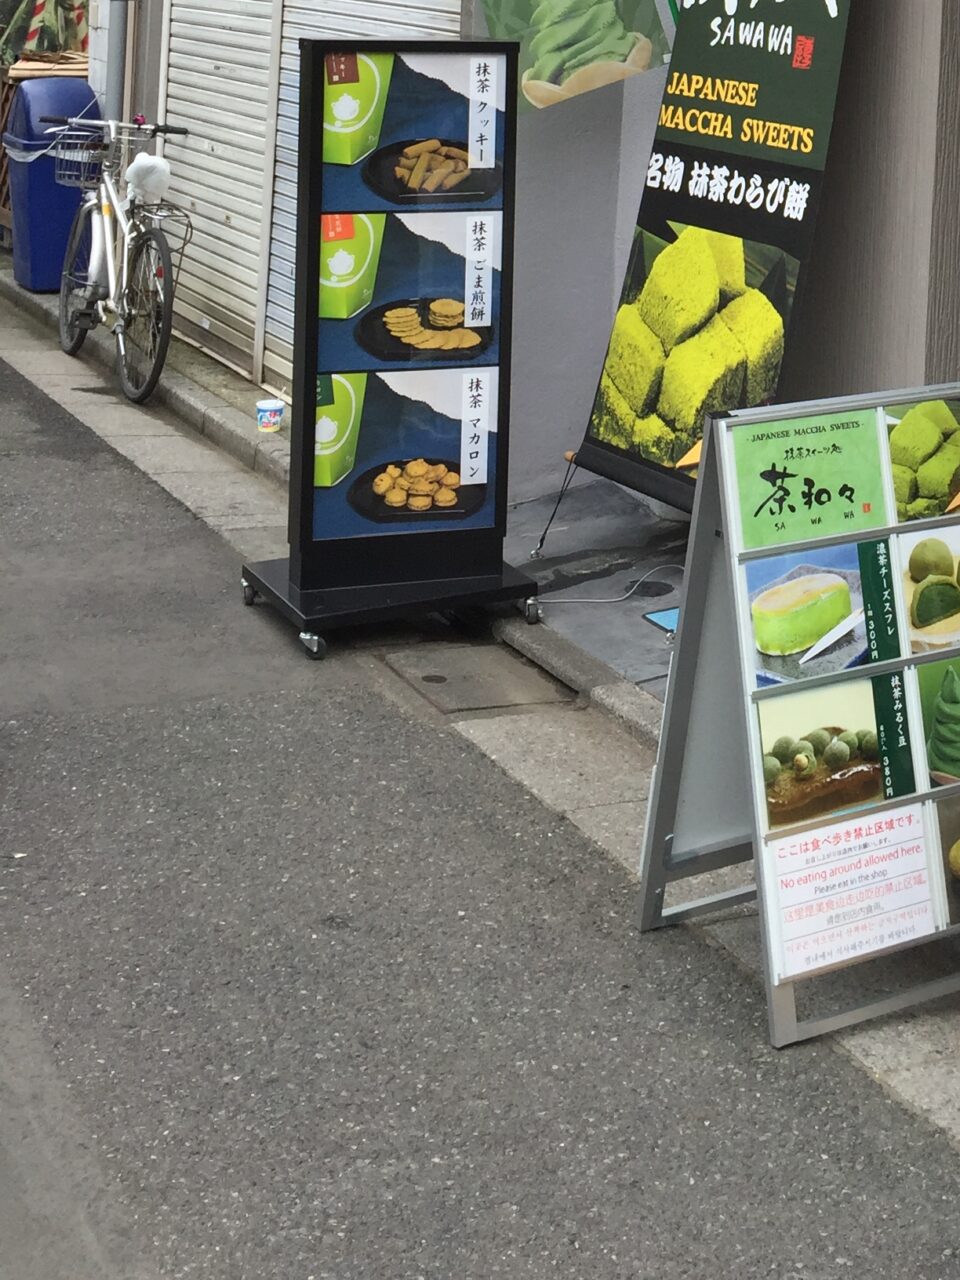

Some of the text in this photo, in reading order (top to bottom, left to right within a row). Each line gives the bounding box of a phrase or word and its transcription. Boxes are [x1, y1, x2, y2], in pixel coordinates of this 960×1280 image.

[667, 71, 759, 108] JAPANESE
[475, 62, 491, 161] 抹茶 クッキー
[657, 103, 815, 154] MACCHA SWEETS
[645, 152, 811, 221] 名物 抹茶わらび餅
[470, 220, 487, 321] 抹茶 ごま煎餅
[468, 377, 483, 477] 抹茶 マカロン
[752, 421, 860, 442] JAPANESE MACCHA SWEETS
[754, 462, 855, 519] 茶和々
[775, 521, 786, 531] SA
[843, 510, 855, 520] WA
[869, 620, 878, 659] 300円
[883, 756, 893, 797] 380円
[781, 879, 795, 890] No
[797, 871, 827, 886] eating
[829, 860, 862, 876] around
[864, 848, 899, 868] allowed
[814, 881, 837, 894] Please
[838, 879, 849, 889] eat
[858, 872, 870, 882] the
[870, 869, 888, 881] shop
